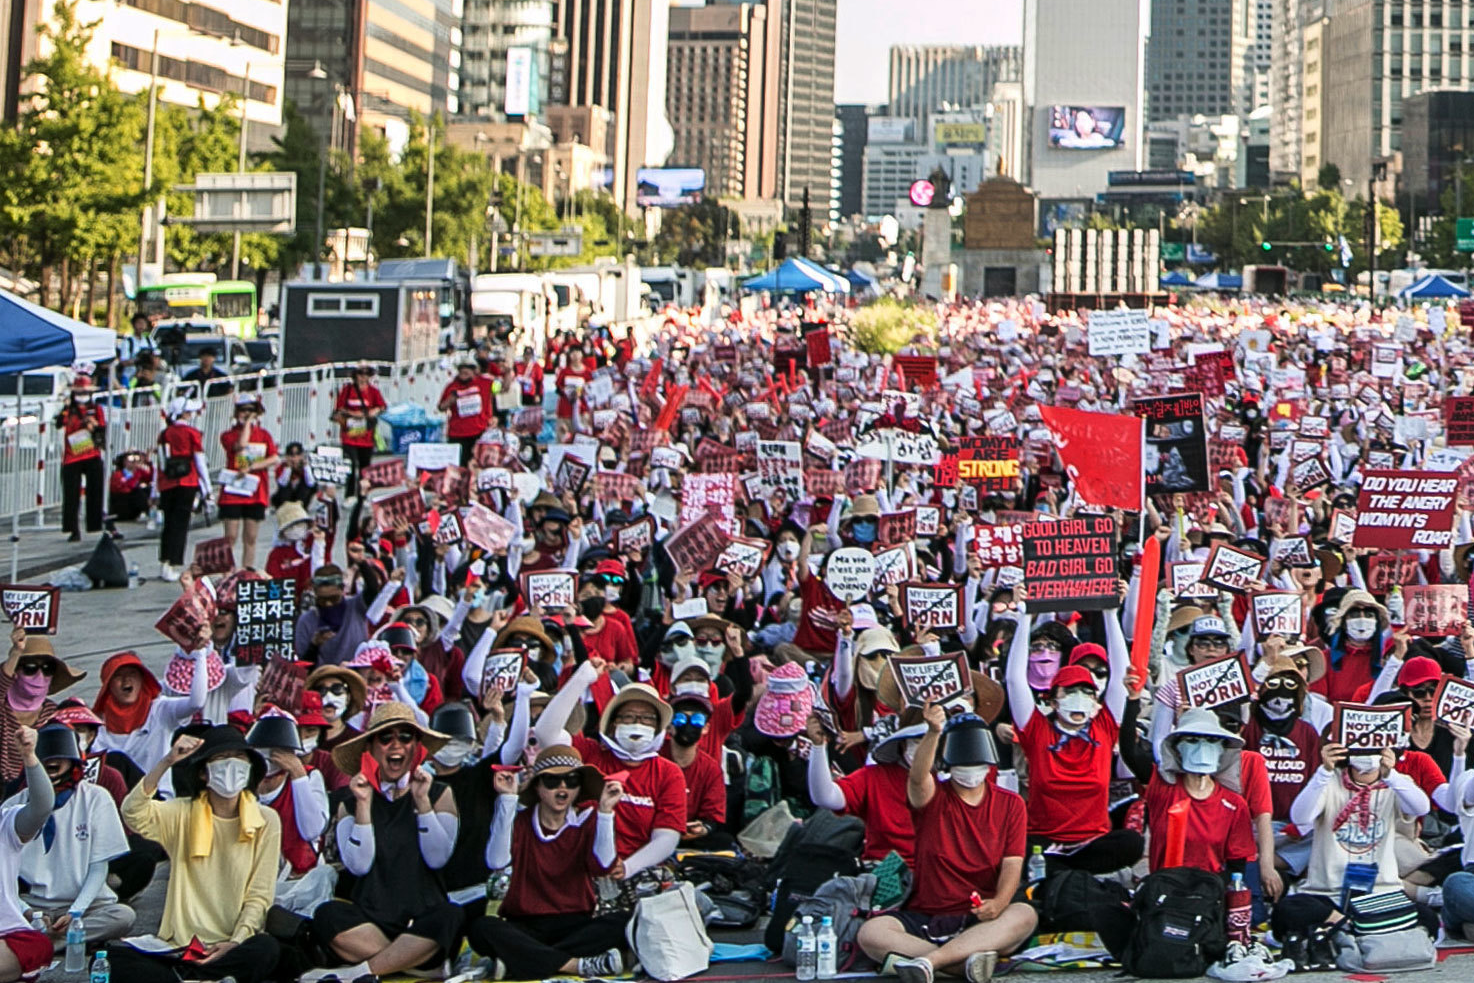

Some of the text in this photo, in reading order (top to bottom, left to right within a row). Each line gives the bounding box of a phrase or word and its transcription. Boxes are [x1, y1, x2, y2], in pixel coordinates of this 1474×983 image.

[960, 438, 1018, 449] WOMYN
[973, 449, 1009, 460] ARE
[959, 460, 1020, 477] STRONG
[1363, 477, 1457, 493] DO YOU HEAR
[1370, 495, 1452, 510] THE ANGRY
[1358, 512, 1428, 528] WOMYN'S
[1023, 517, 1113, 538] GOOD GIRL GO
[1411, 531, 1451, 545] ROAR
[1034, 537, 1111, 556] TO HEAVEN
[835, 556, 867, 564] Ma vie
[1217, 558, 1236, 571] NOT
[855, 567, 872, 575] pas
[1026, 557, 1114, 578] BAD GIRL GO
[1212, 566, 1252, 589] PORN
[238, 578, 296, 602] 보는놈도
[832, 582, 868, 591] PORNO
[1027, 578, 1117, 599] EVERYWHERE
[1177, 583, 1214, 595] PORN
[532, 593, 569, 604] PORN
[910, 591, 943, 600] MY LIFE
[911, 600, 931, 609] NOT
[1257, 600, 1270, 608] MY
[12, 611, 46, 627] ORN
[237, 600, 296, 624] 범죄자다
[912, 610, 953, 624] PORN
[1258, 609, 1276, 617] NOT
[236, 620, 294, 645] 범죄자를
[1260, 619, 1297, 632] PORN
[905, 665, 923, 674] MY
[1189, 666, 1224, 683] MY LIFE
[908, 673, 933, 683] NOT
[1190, 672, 1238, 692] NOT YOUR
[911, 679, 957, 697] PORN
[1192, 681, 1242, 706] PORN
[1448, 683, 1464, 694] MY
[1445, 692, 1467, 706] NOT
[1347, 713, 1386, 722] MY LIFE
[1346, 722, 1398, 732] NOT YOUR
[1346, 732, 1397, 746] PORN
[1277, 760, 1306, 770] LOUD
[1274, 773, 1304, 783] HARD
